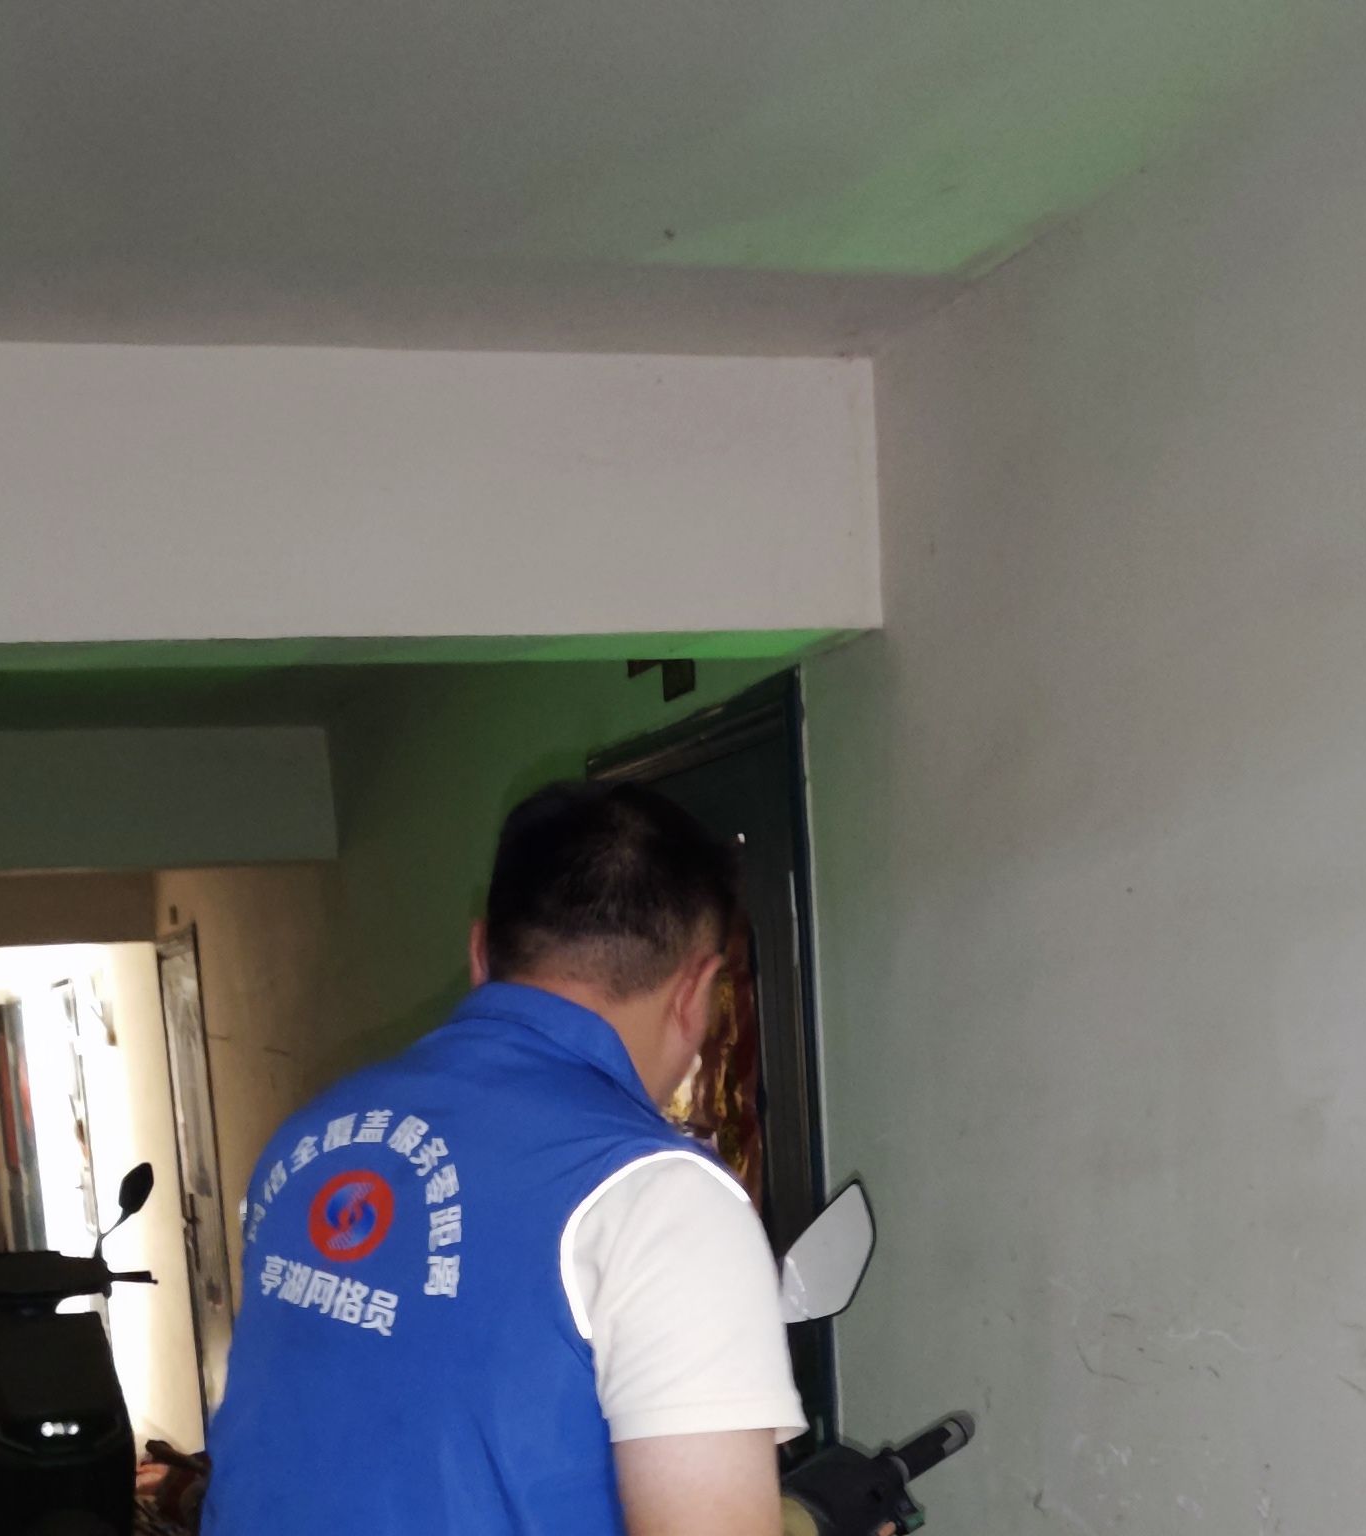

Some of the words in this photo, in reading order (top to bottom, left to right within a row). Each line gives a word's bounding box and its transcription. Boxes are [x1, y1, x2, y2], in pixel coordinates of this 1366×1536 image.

[260, 1254, 399, 1337] 亭湖网格员
